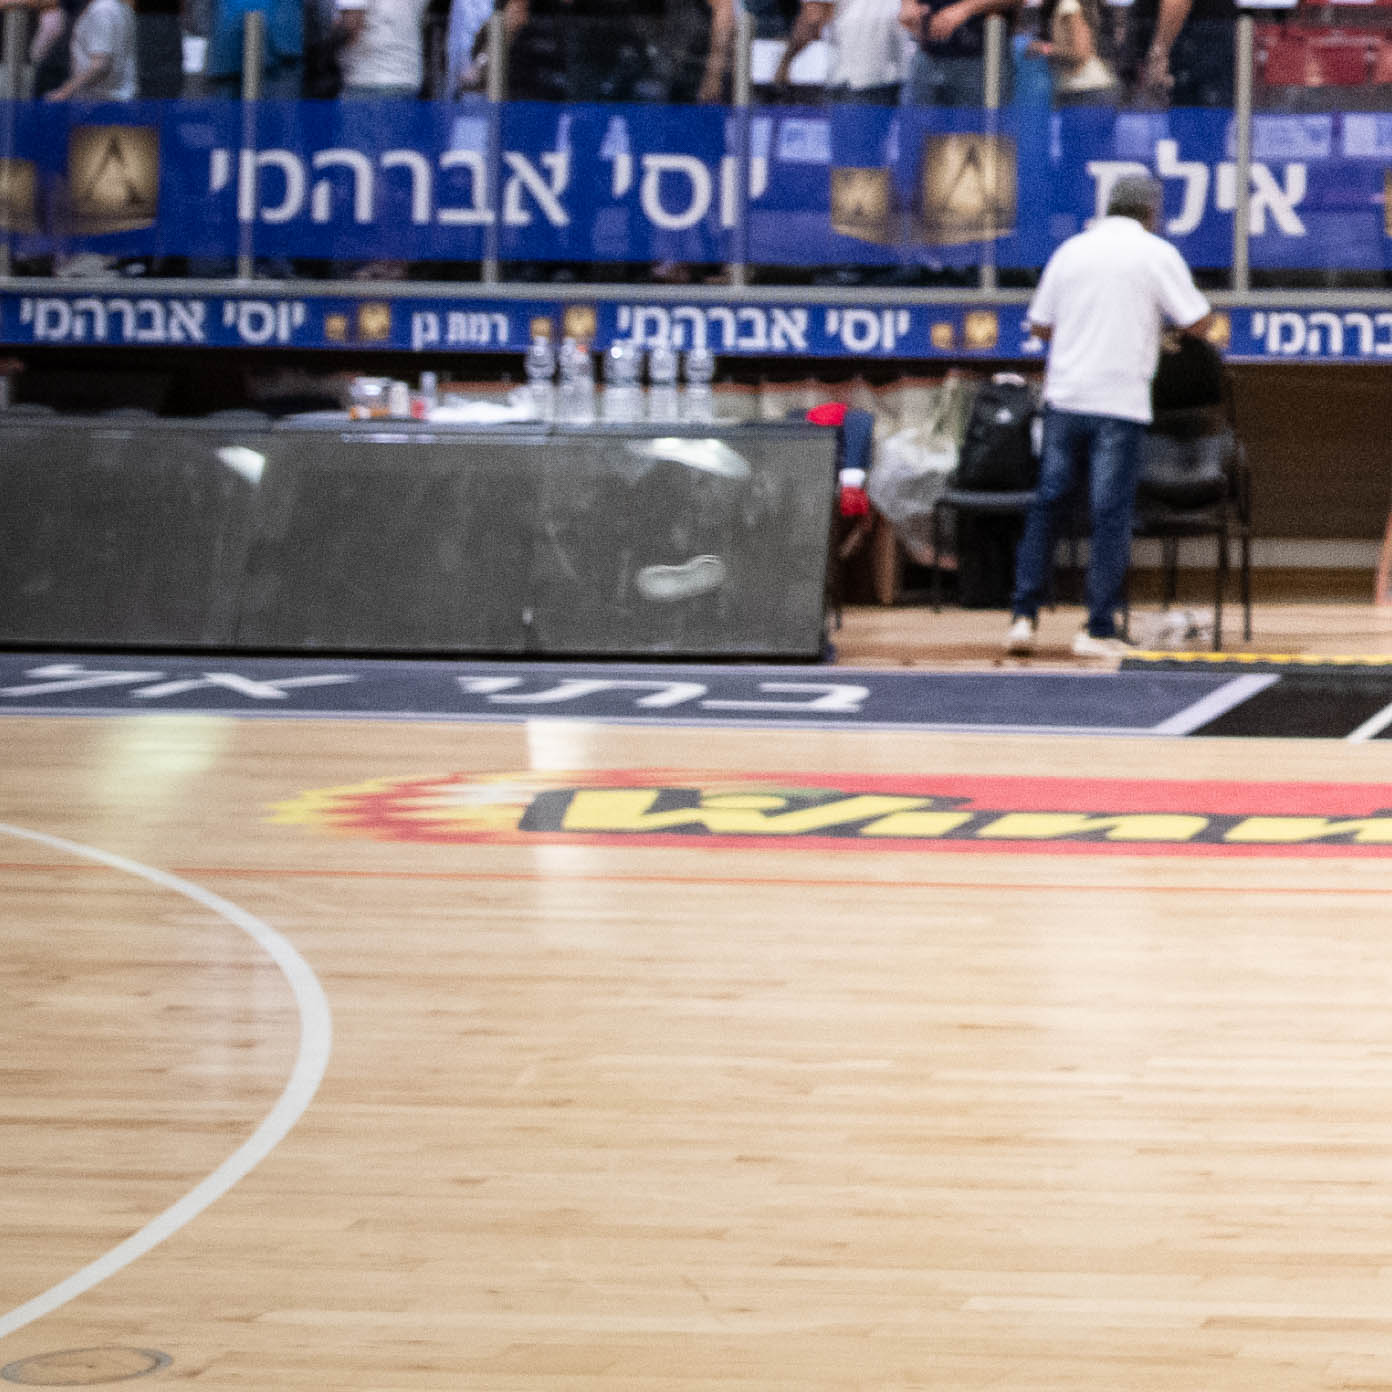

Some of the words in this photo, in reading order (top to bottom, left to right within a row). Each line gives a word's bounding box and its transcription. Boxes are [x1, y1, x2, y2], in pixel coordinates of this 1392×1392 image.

[210, 147, 570, 228] אברהמי
[611, 150, 769, 229] יוסי
[20, 297, 203, 344] אברהמי
[223, 299, 304, 343] יוסי
[616, 304, 803, 351] אברהמי
[827, 310, 909, 350] יוסי
